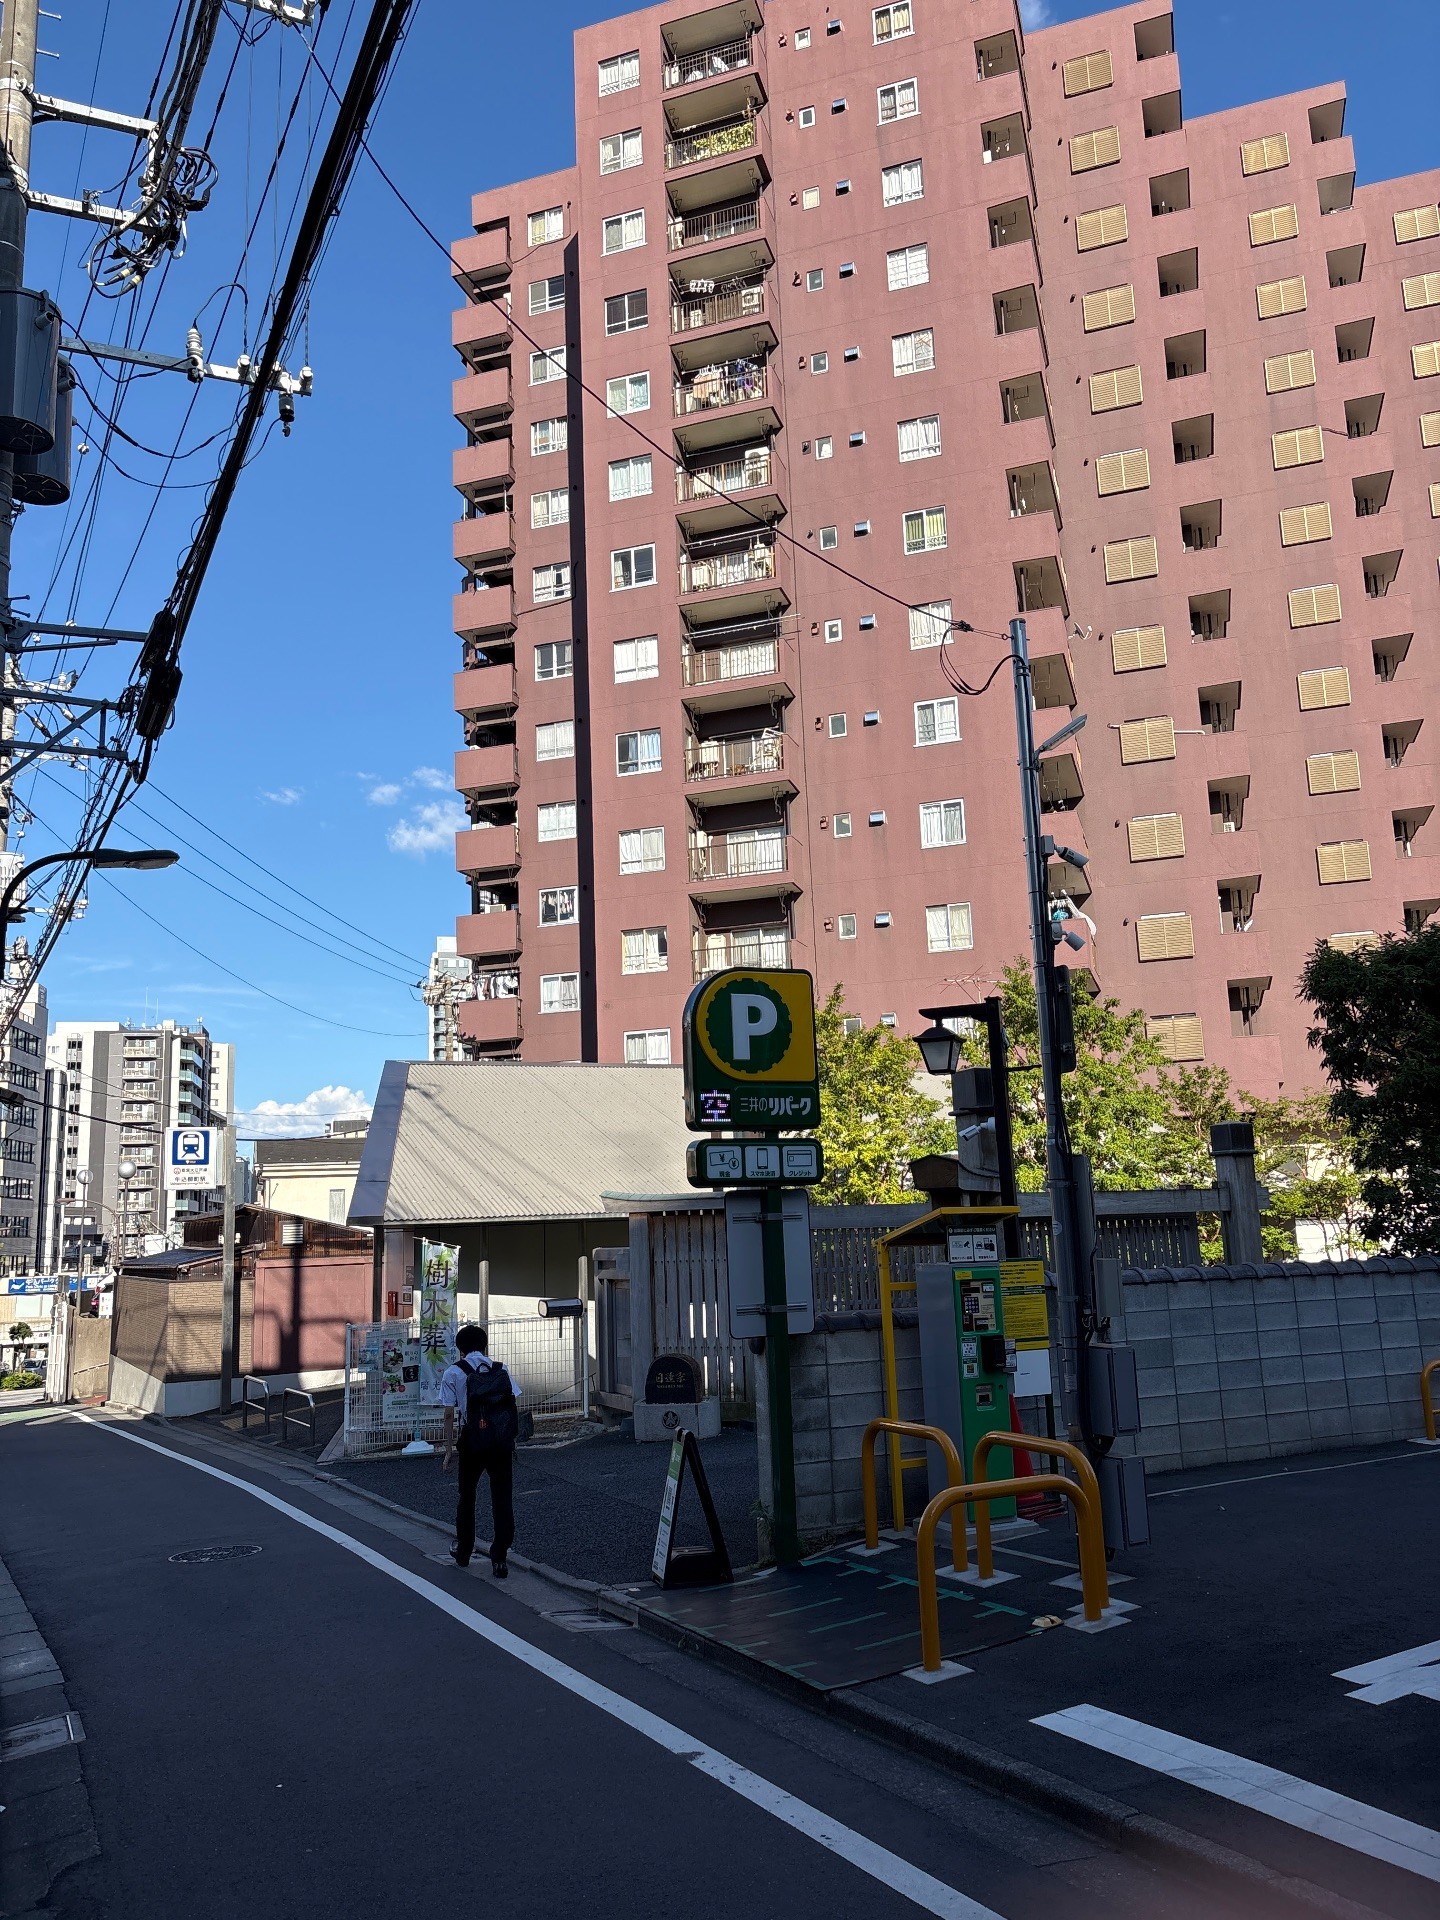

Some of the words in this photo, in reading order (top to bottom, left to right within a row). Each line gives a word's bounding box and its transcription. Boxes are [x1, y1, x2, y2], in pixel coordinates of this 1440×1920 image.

[730, 993, 778, 1060] P
[701, 1089, 732, 1122] 空
[739, 1095, 812, 1116] 三井のリパーク
[421, 1259, 452, 1354] 樹木葬
